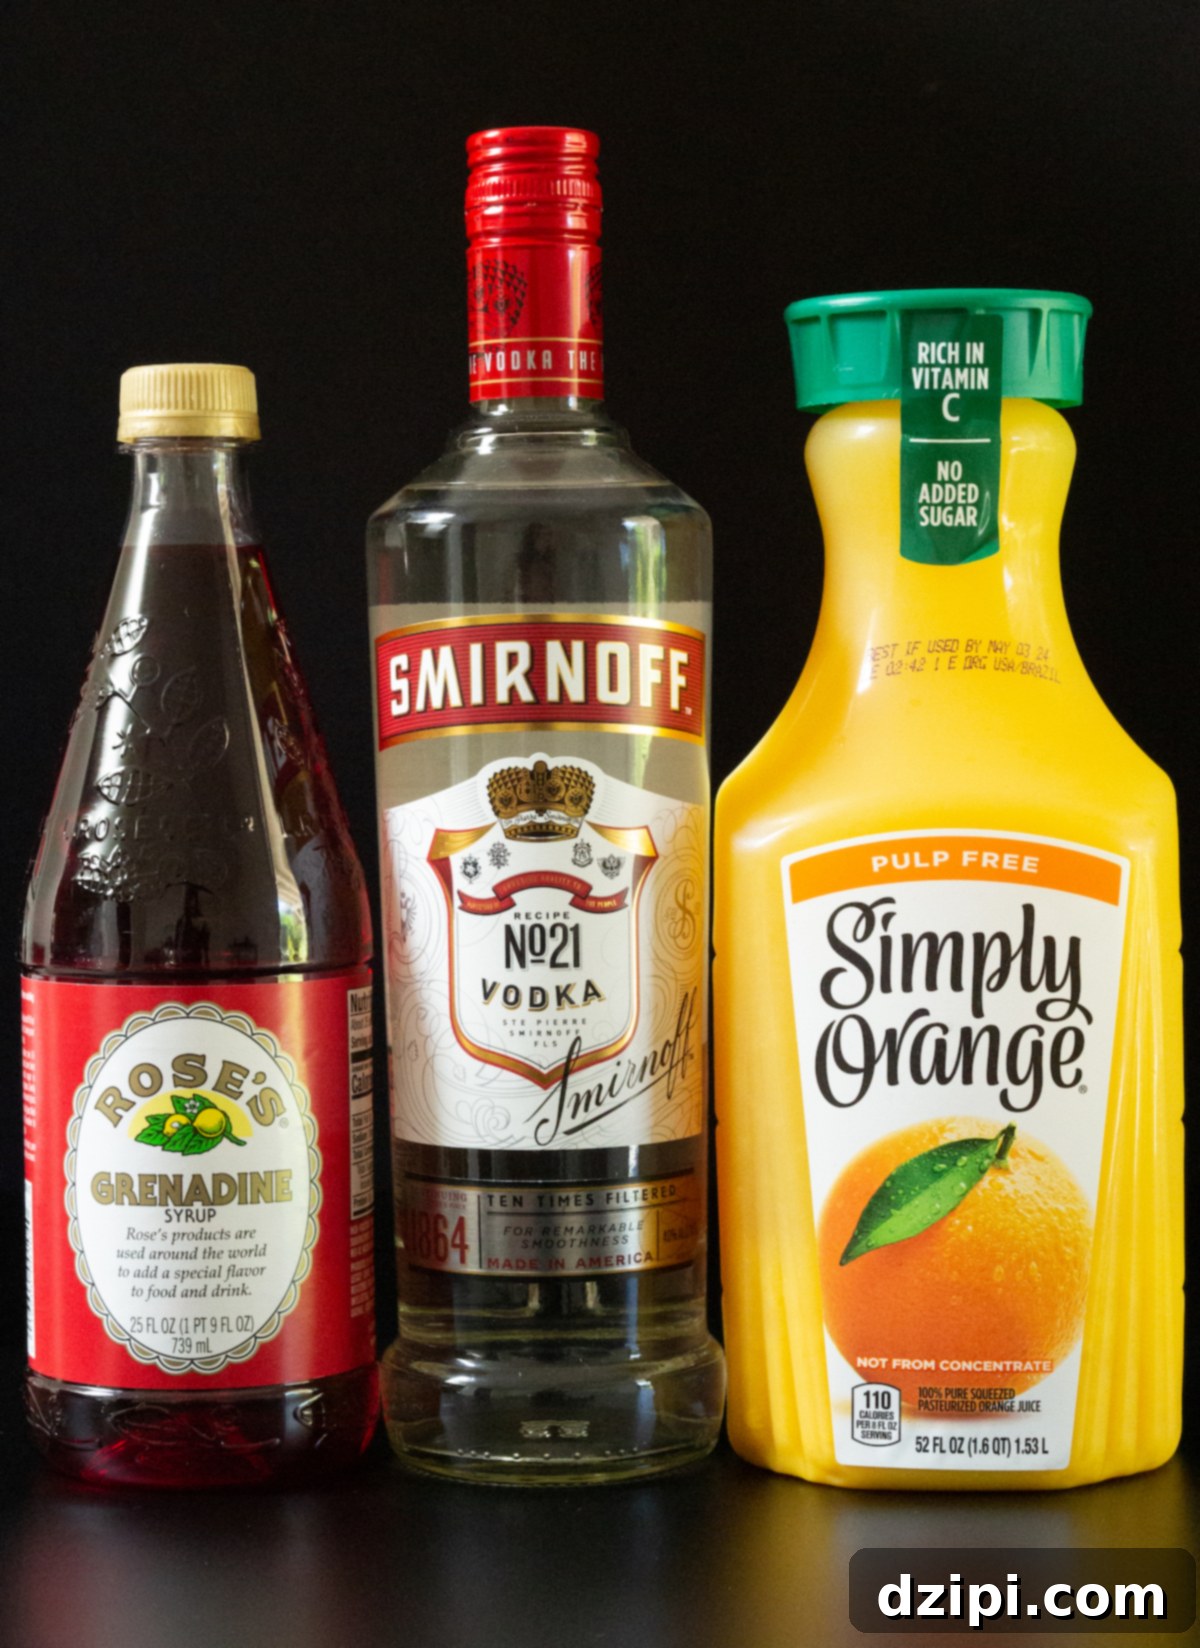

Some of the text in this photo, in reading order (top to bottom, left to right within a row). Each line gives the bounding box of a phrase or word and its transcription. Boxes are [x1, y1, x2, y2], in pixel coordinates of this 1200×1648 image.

[484, 350, 553, 373] VODKA
[917, 341, 985, 364] RICH IN
[911, 367, 990, 390] VITAMIN
[941, 392, 961, 422] C
[936, 460, 963, 482] NO
[918, 483, 980, 504] ADDED
[919, 506, 978, 527] SUGAR
[905, 640, 922, 657] IF
[926, 638, 960, 654] USED
[964, 639, 983, 654] BY
[987, 639, 1012, 655] MAY
[389, 639, 690, 717] SMIRNOFF
[870, 849, 1041, 874] PULP FREE
[513, 912, 571, 920] RECIPE
[819, 896, 1094, 1026] Simply
[481, 977, 605, 1012] VODKA
[502, 1017, 588, 1026] STE PIERRE
[509, 1029, 581, 1038] SMIRNOFF
[533, 1040, 558, 1048] FLS
[814, 1007, 1086, 1113] Orange
[94, 1053, 286, 1128] ROSE'S
[90, 1169, 293, 1208] GRENADINE
[487, 1185, 676, 1208] TEN TIMES FILTERED
[164, 1207, 217, 1224] SYRUP
[126, 1226, 257, 1245] Rose's products are
[503, 1220, 645, 1237] FOR REMARKABLE
[116, 1243, 267, 1260] used around the world
[520, 1235, 630, 1250] SMOOTHNESS
[487, 1250, 654, 1270] MADE IN AMERICA
[117, 1263, 267, 1283] to add a special flavor
[130, 1282, 252, 1302] to food and drink.
[130, 1314, 255, 1336] 25 FL OZ (1 PT 9 FL OZ)
[171, 1336, 213, 1354] 739 mL
[856, 1356, 1052, 1372] NOT FROM CONCENTRATE
[863, 1389, 892, 1410] 110
[918, 1386, 1016, 1400] 100% PURE SQUEEZED
[859, 1410, 895, 1421] CALORIES
[917, 1399, 1042, 1413] PASTEURIZED ORANGE JUICE
[856, 1419, 871, 1430] PER
[860, 1429, 893, 1440] SERVING
[915, 1436, 1049, 1458] 52 FL OZ (1.6 QT) 1.53 L
